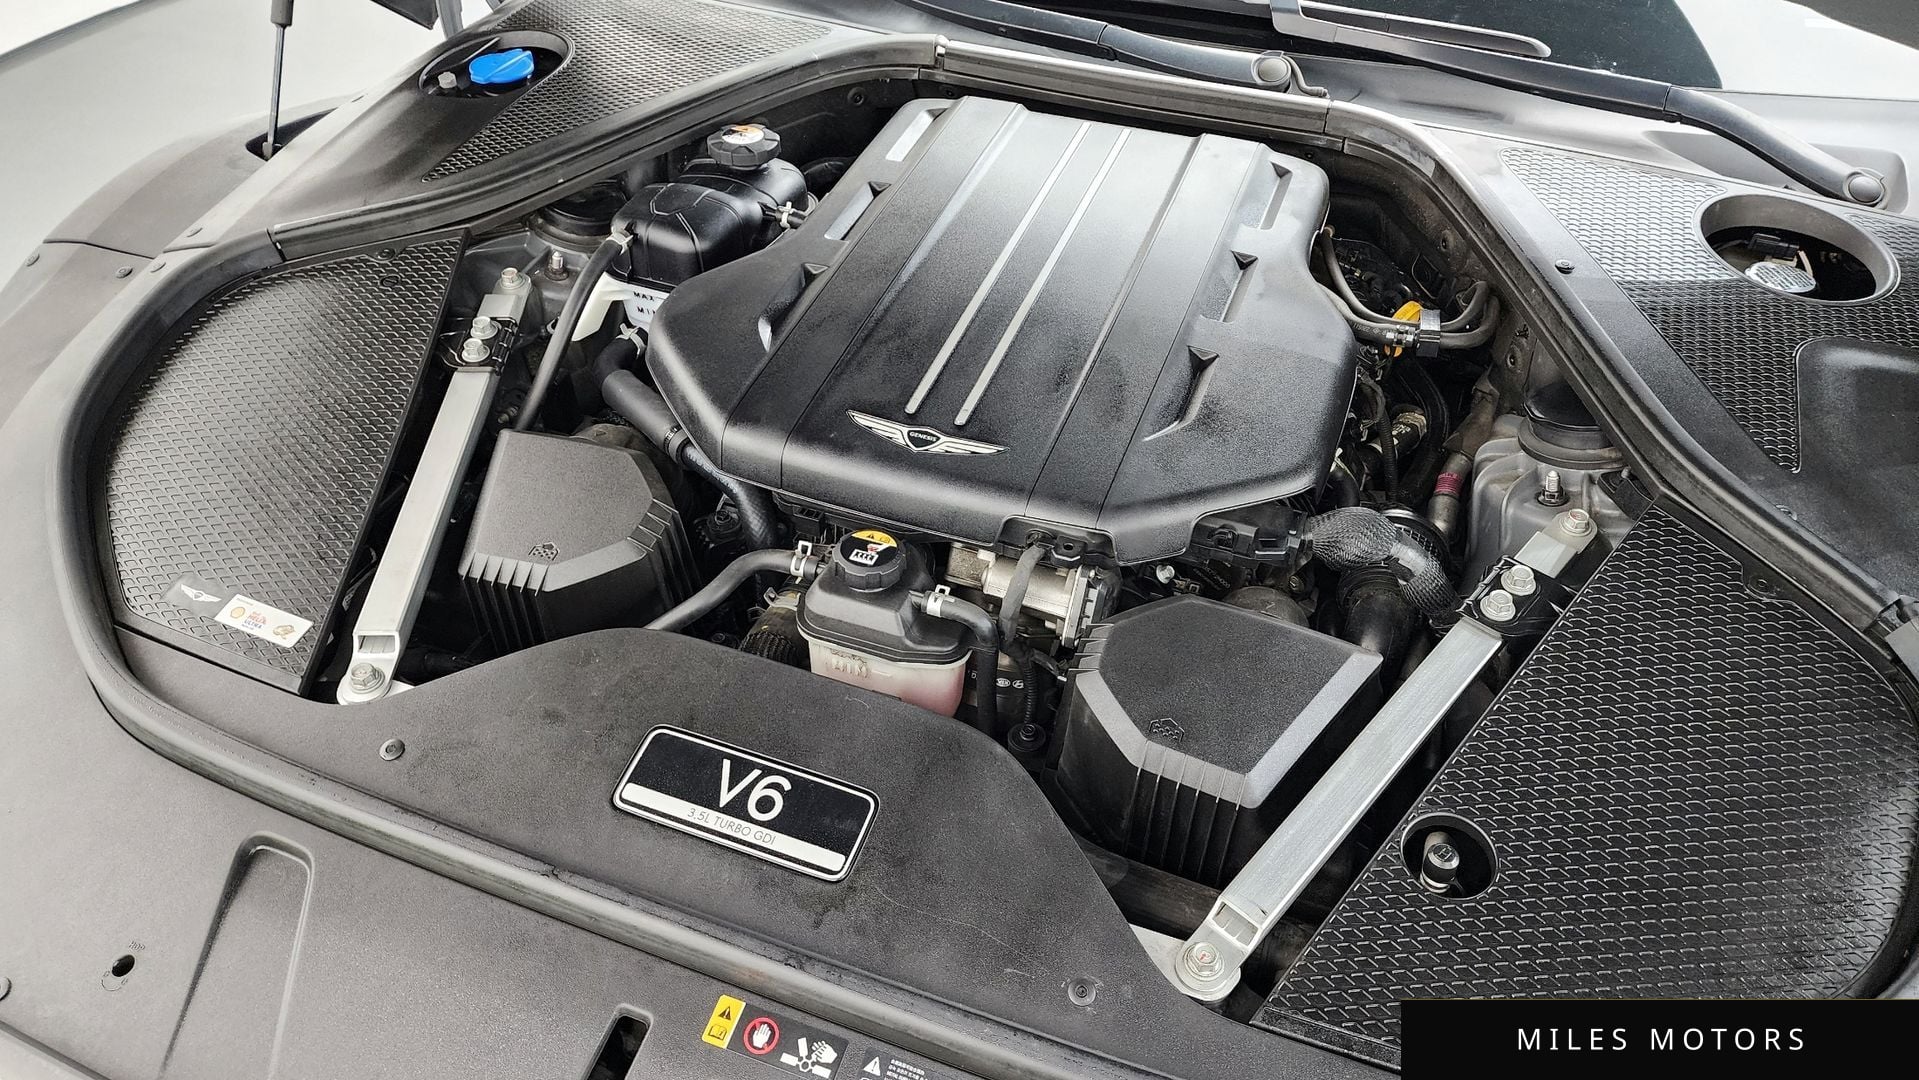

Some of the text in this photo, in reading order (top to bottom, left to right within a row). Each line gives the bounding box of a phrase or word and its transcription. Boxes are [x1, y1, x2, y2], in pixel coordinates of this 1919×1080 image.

[909, 431, 938, 442] GENESIS
[719, 758, 792, 822] V6
[687, 807, 777, 846] 3.5L TURBO GDI
